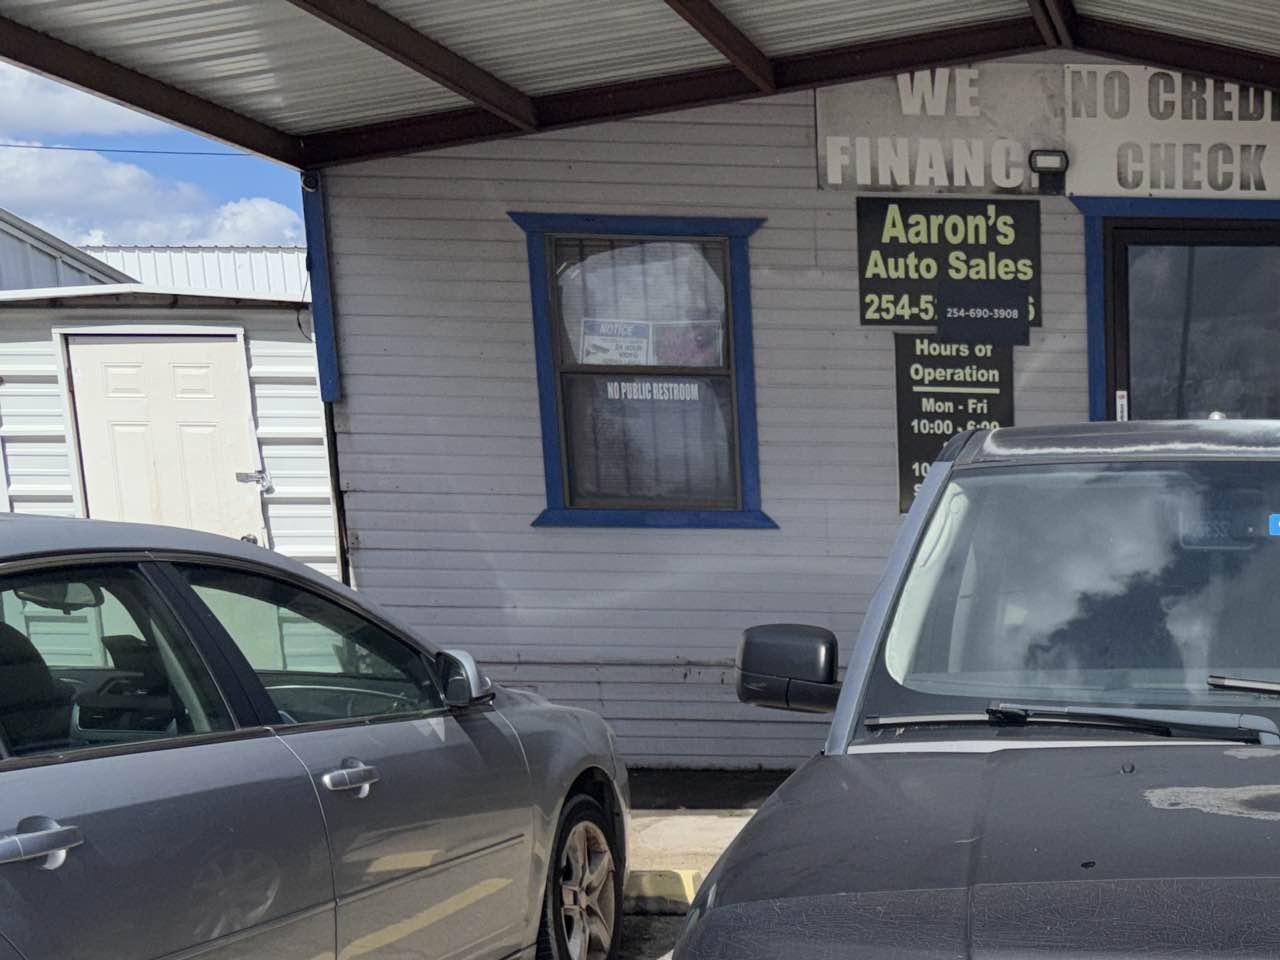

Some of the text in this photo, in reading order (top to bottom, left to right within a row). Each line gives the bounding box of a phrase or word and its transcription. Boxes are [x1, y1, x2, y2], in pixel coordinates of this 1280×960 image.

[897, 67, 980, 116] WE
[1071, 70, 1130, 119] NO
[826, 136, 1039, 189] FINANC
[1117, 142, 1267, 191] CHECK
[881, 204, 1015, 245] Aaron's
[864, 250, 1033, 280] Auto Sales
[946, 308, 1019, 319] 254-690-3908
[601, 323, 633, 336] NOTICE
[915, 339, 969, 357] Hours
[910, 364, 1000, 384] Operation
[607, 382, 699, 401] NO PUBLIC RESTROOM
[922, 398, 954, 413] Mon
[968, 399, 988, 414] Fri
[911, 419, 953, 434] 10:00
